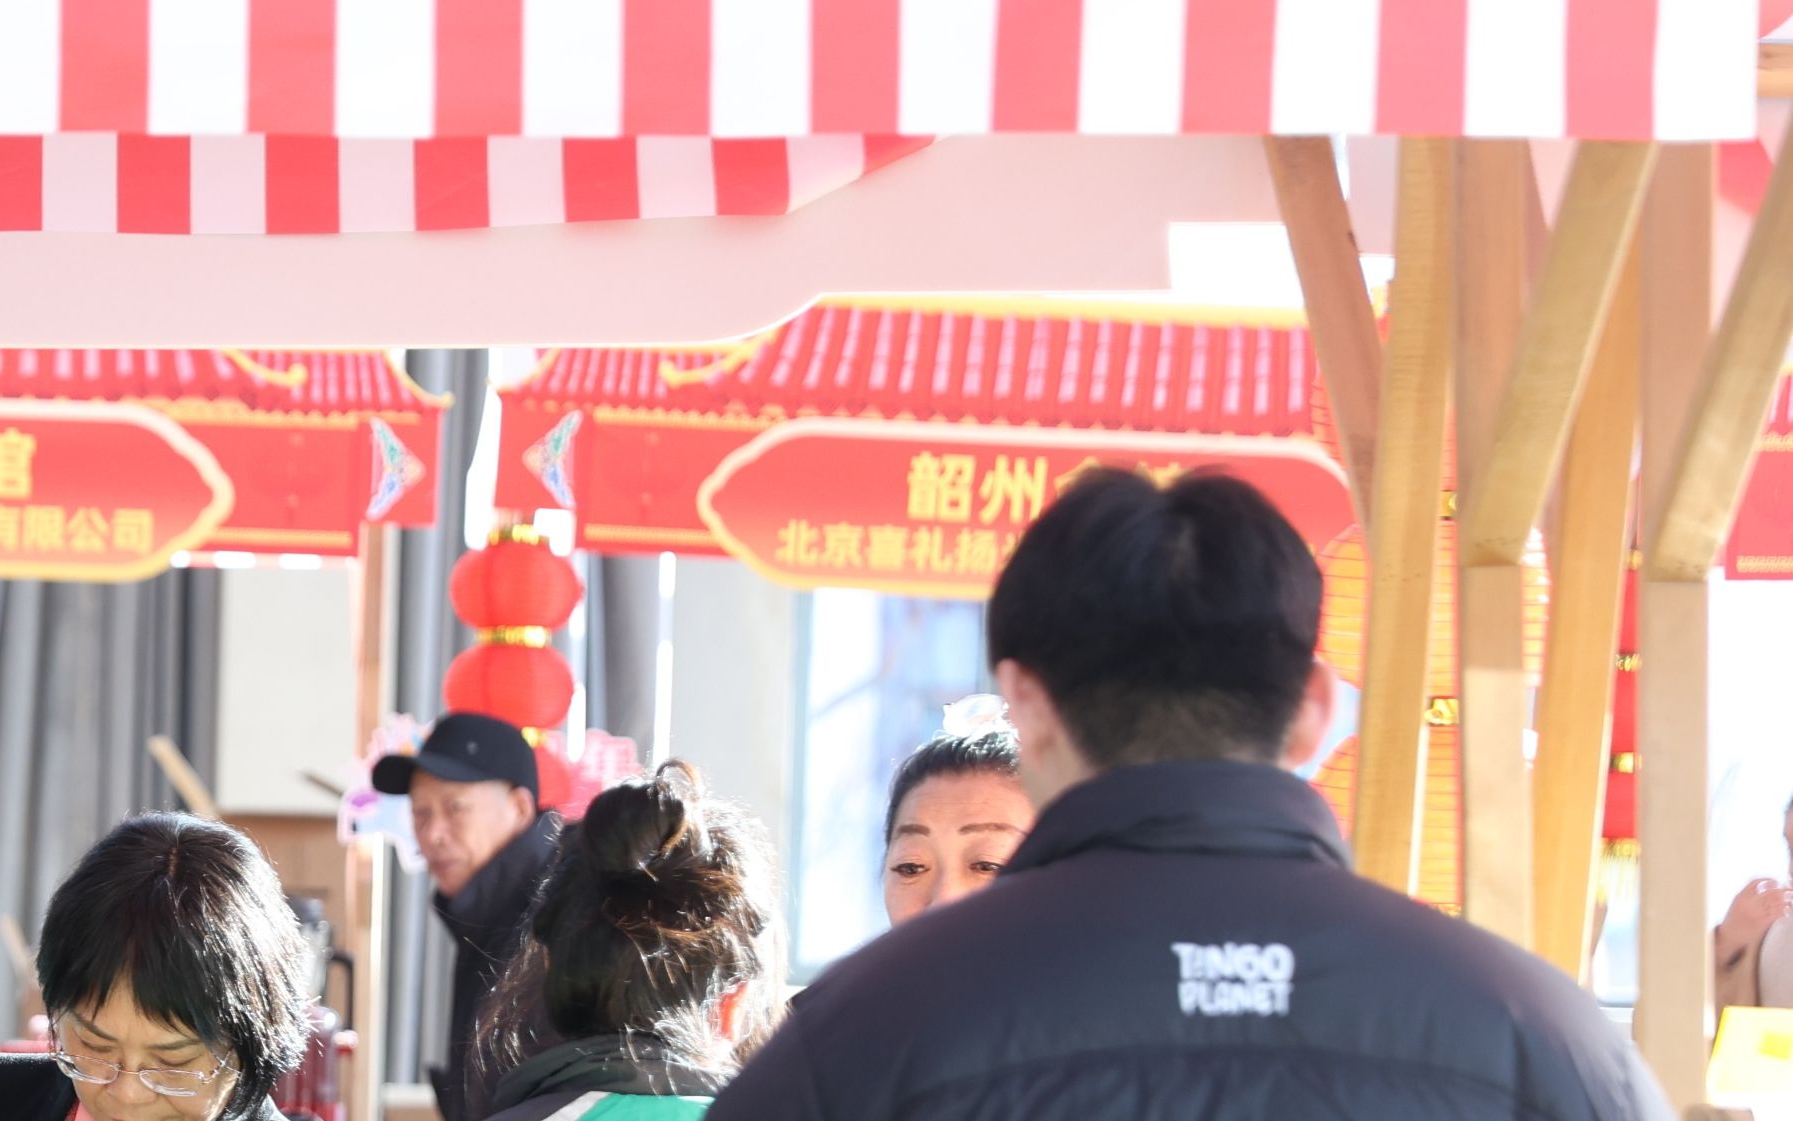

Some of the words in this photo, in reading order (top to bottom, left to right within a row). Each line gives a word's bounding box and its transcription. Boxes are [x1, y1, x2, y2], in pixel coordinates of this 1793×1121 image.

[776, 519, 1016, 576] 北京喜礼扬
